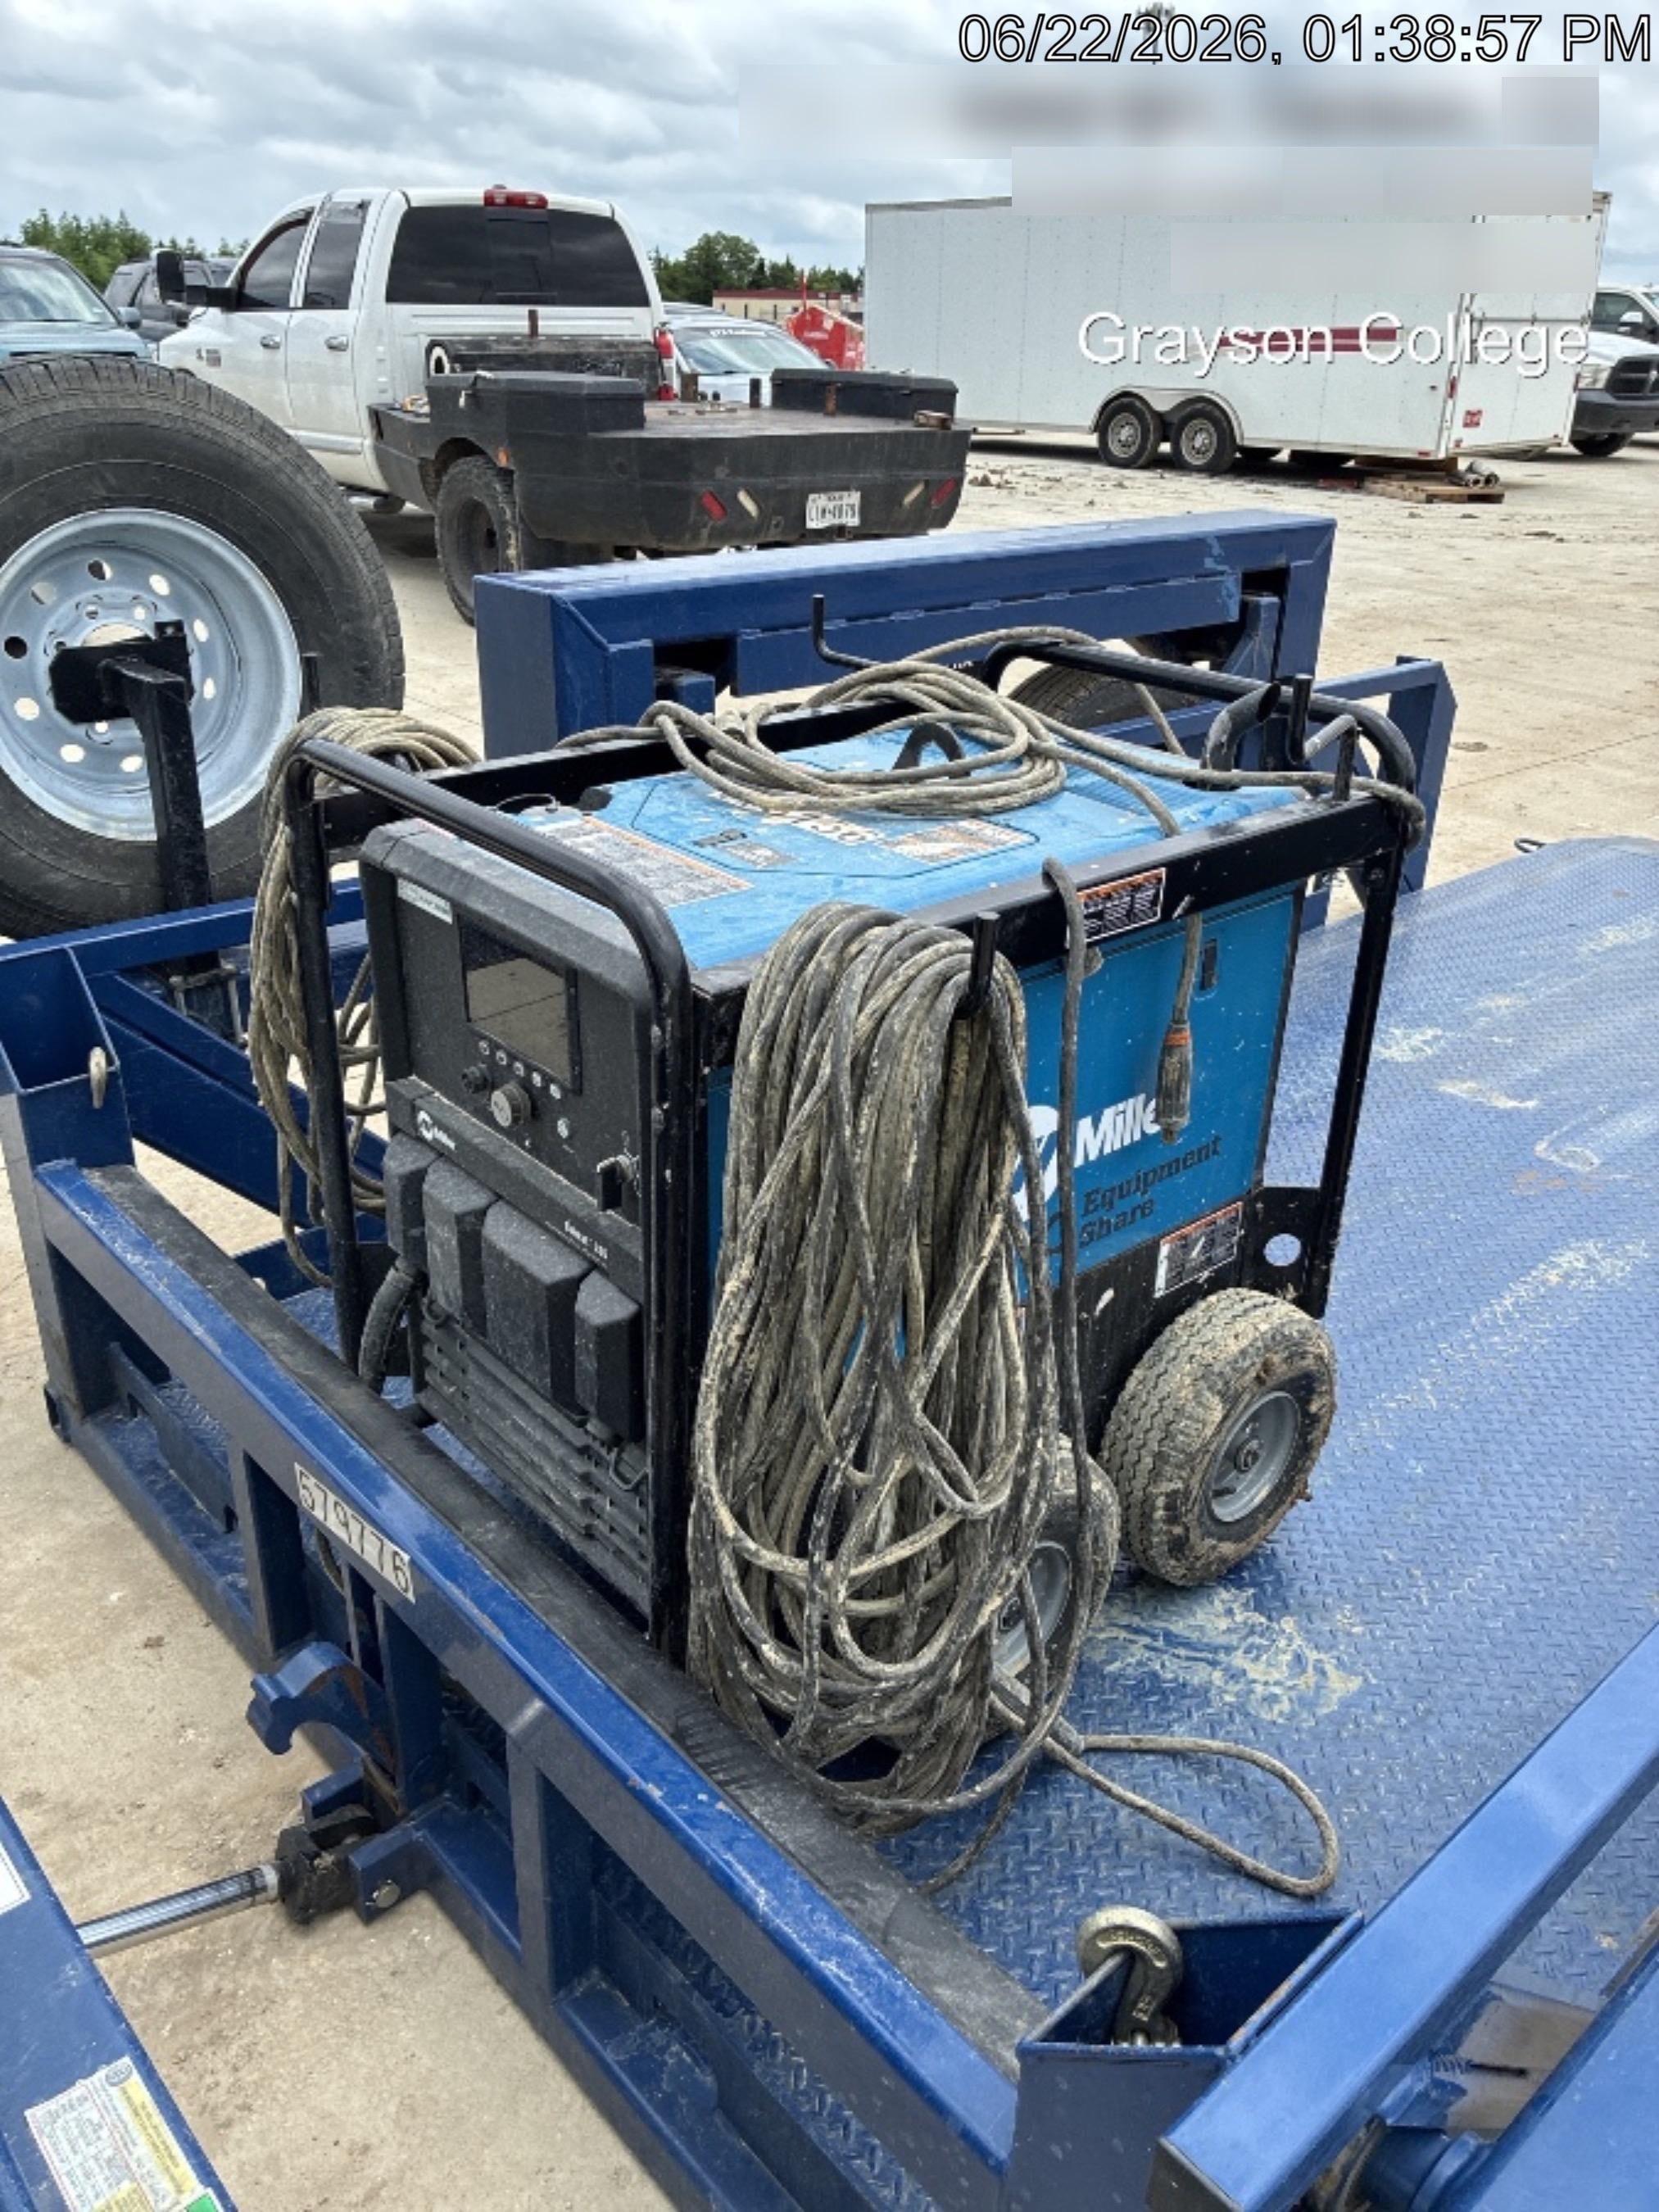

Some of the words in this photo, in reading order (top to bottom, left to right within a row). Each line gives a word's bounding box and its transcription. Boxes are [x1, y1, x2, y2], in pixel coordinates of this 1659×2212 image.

[1074, 1093, 1161, 1167] Mille
[1082, 1135, 1222, 1217] Equipment
[1078, 1197, 1155, 1249] Share
